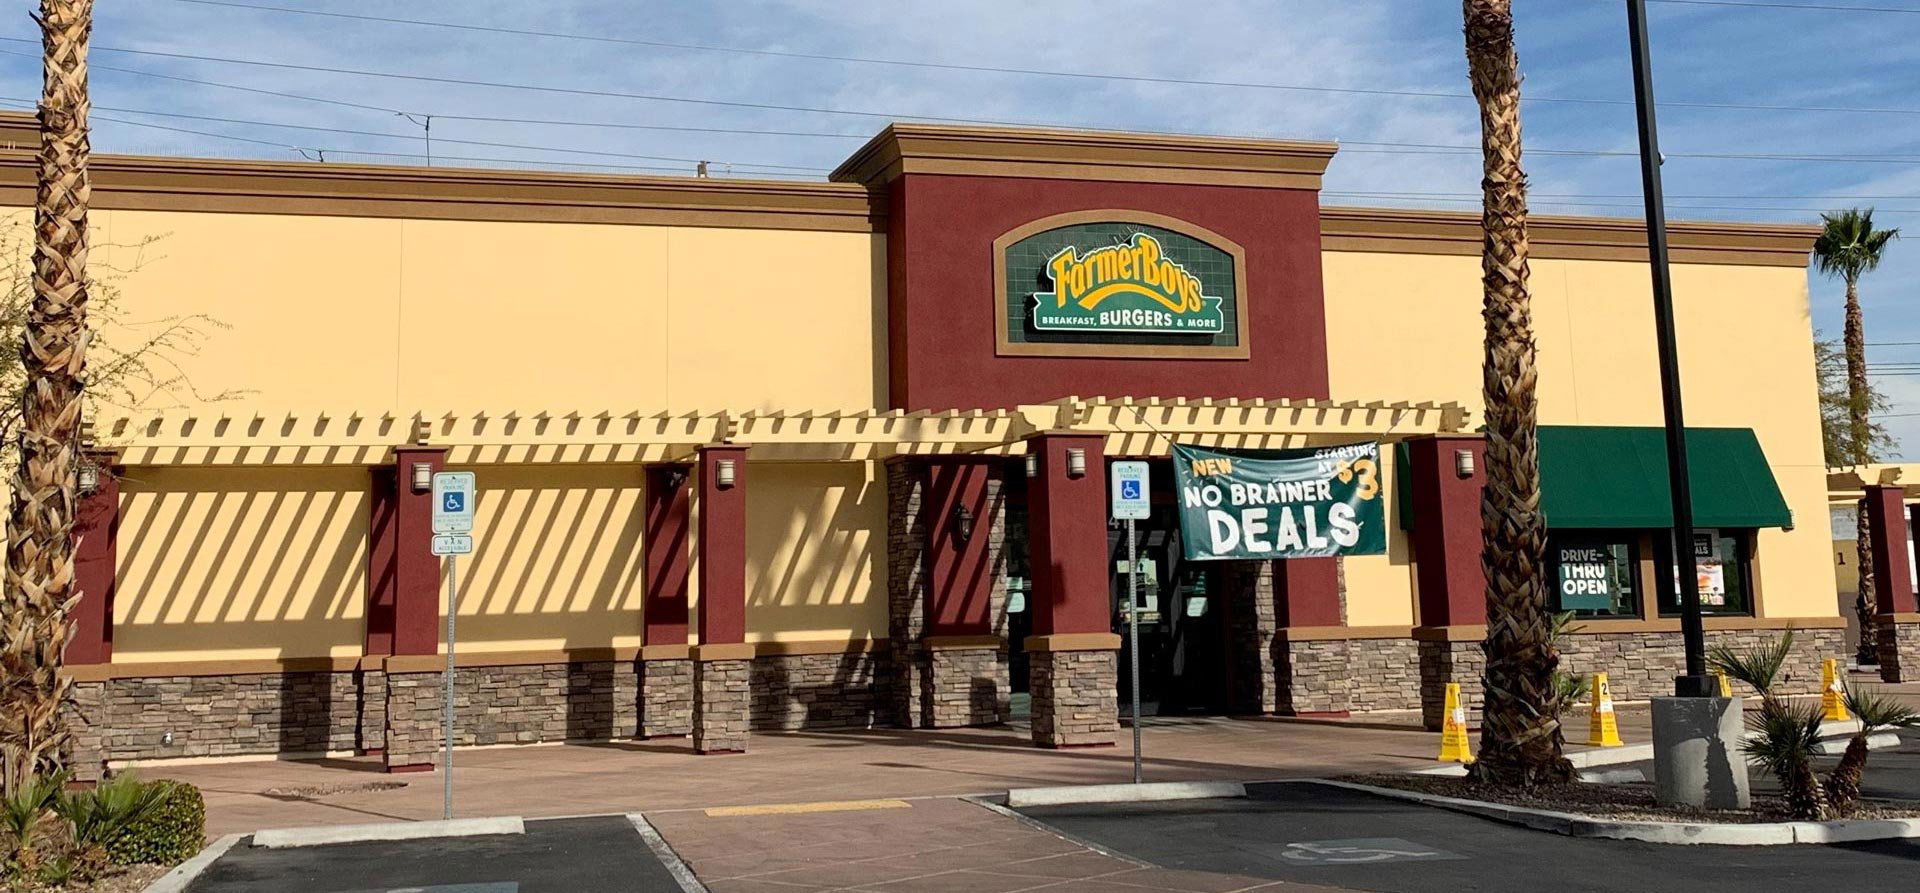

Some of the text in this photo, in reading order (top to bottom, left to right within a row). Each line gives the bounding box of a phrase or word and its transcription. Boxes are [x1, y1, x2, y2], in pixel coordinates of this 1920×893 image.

[1042, 309, 1217, 328] BREAKFAST, BURGERS & MORE
[1314, 442, 1377, 459] STARTING
[1192, 458, 1233, 477] NEW
[1318, 459, 1378, 500] AT $3
[1183, 479, 1333, 508] NO BRAINER
[1207, 502, 1360, 555] DEALS
[1561, 549, 1604, 562] DRIVE-
[1838, 552, 1846, 565] 1
[1562, 563, 1606, 579] THRU
[1562, 580, 1607, 595] OPEN
[1601, 683, 1608, 695] 2
